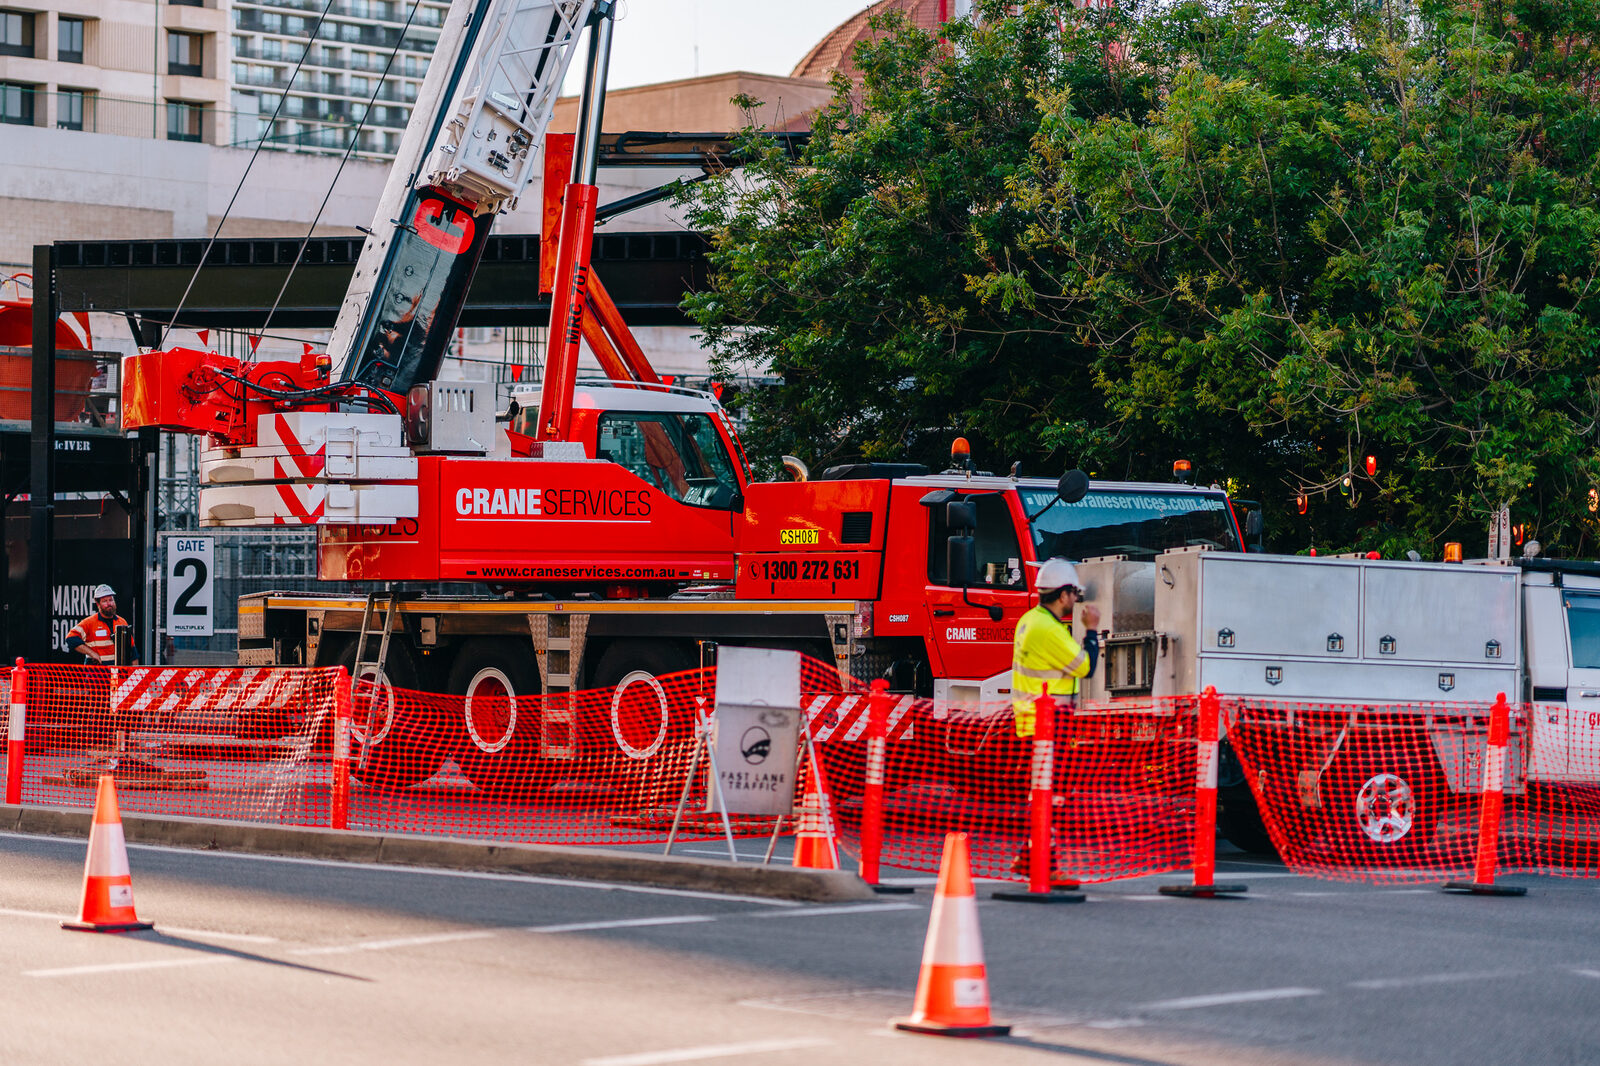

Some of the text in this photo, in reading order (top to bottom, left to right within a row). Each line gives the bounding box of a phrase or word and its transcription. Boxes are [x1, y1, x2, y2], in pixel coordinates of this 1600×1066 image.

[566, 261, 587, 345] MRC 70T
[456, 488, 651, 516] CRANE SERVICES
[781, 530, 819, 544] CSH087
[177, 540, 205, 552] GATE
[482, 566, 676, 579] www.craneservices.com.au
[762, 560, 859, 580] 1300 272 631
[173, 558, 208, 616] 2
[52, 585, 97, 617] MARKE
[889, 614, 910, 623] CSH087
[946, 627, 977, 641] CRANE
[721, 771, 785, 783] FAST LANE
[728, 781, 778, 792] TRAFFIC
